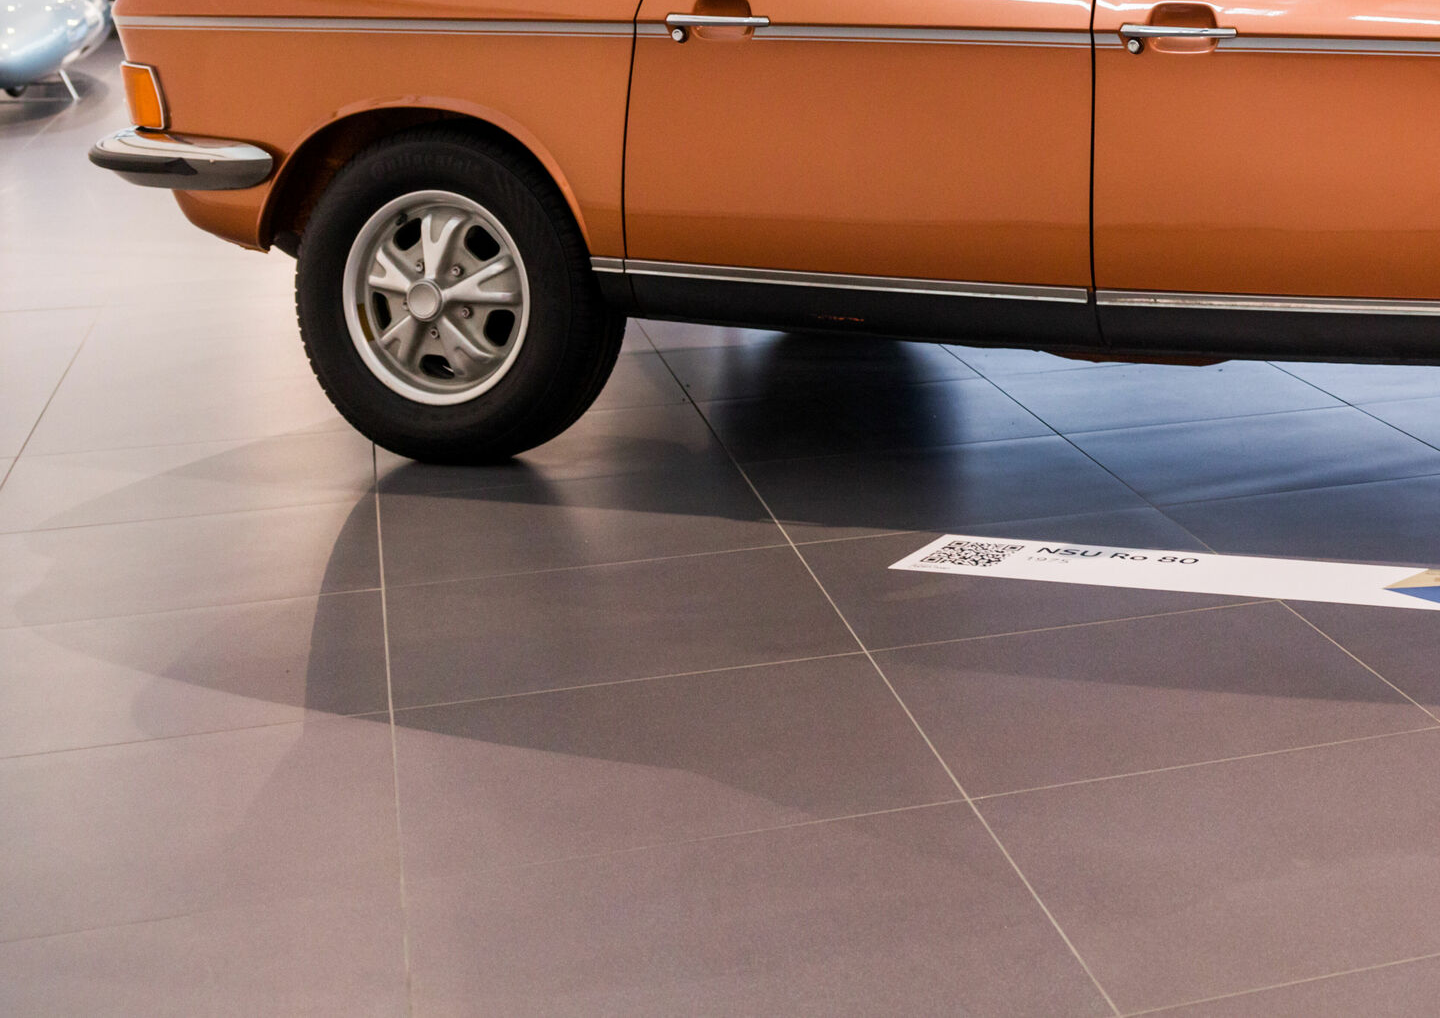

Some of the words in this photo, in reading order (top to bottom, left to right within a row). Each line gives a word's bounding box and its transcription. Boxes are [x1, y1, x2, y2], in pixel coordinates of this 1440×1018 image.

[1036, 546, 1103, 558] NSU
[1110, 552, 1149, 561] Ro
[1157, 555, 1200, 565] 80
